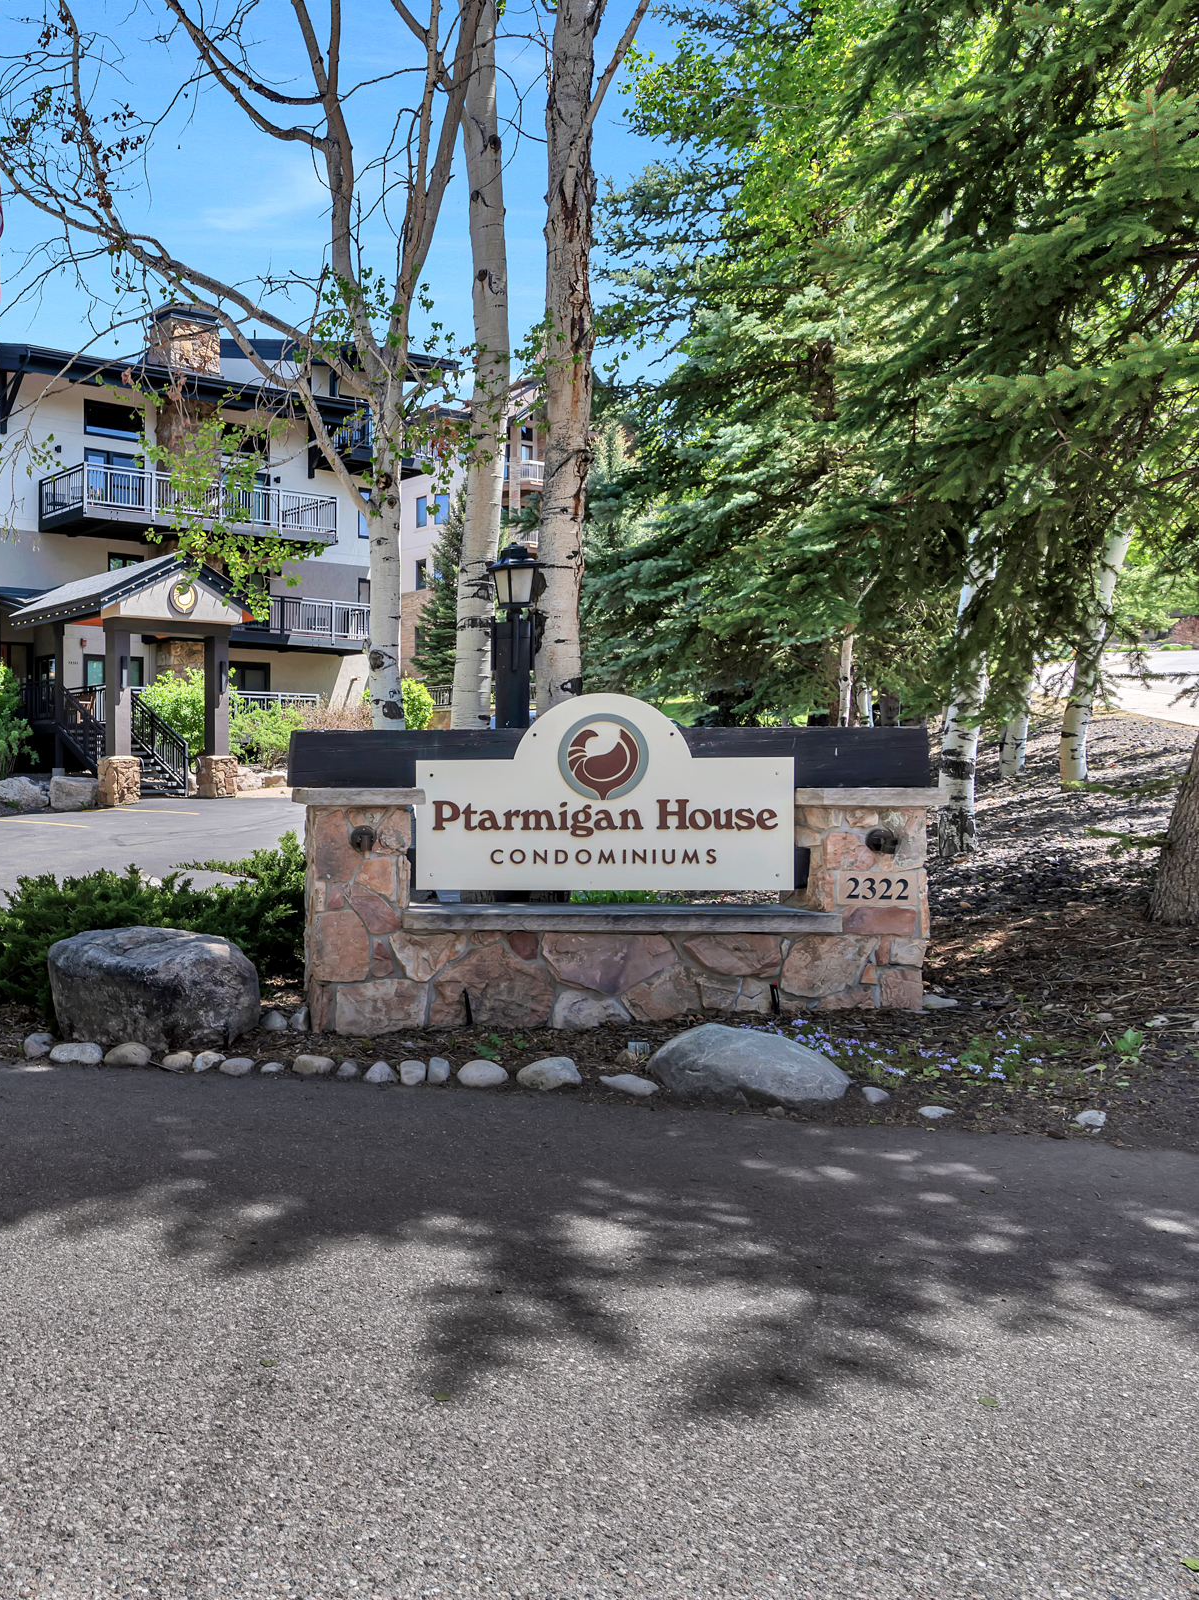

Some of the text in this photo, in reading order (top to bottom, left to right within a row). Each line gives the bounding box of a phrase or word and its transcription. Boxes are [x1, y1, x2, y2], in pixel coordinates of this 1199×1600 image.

[432, 799, 779, 838] Ptarmigan House
[490, 848, 717, 865] CONDOMINIUMS
[845, 877, 909, 900] 2322
